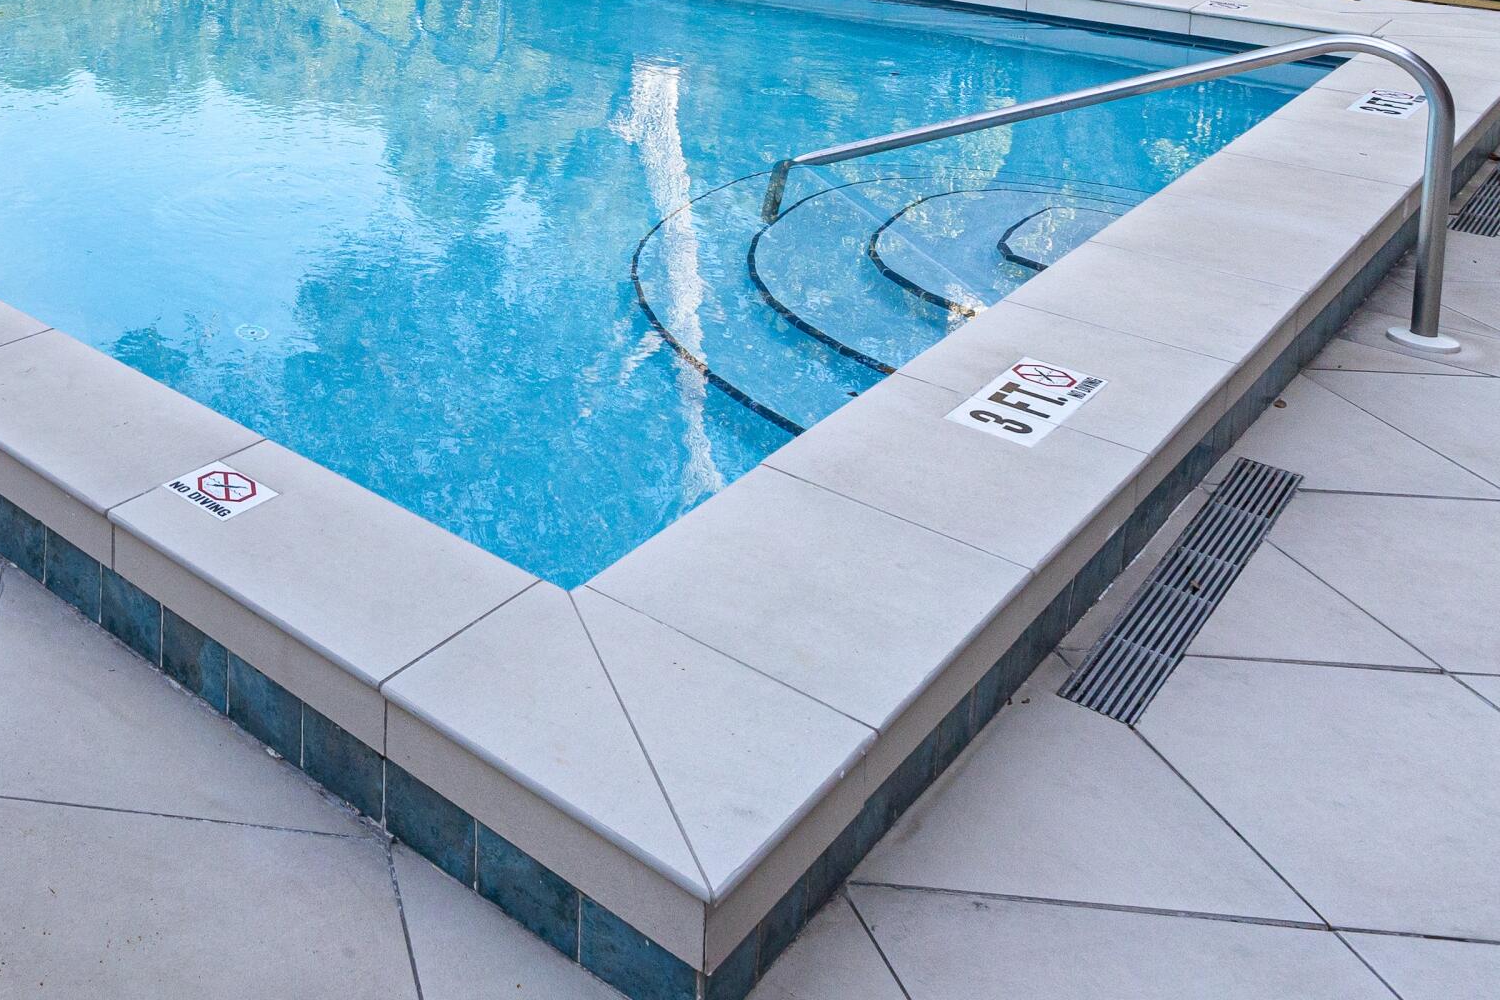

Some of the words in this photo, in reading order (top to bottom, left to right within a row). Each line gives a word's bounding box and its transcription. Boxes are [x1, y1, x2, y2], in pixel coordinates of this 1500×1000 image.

[1359, 106, 1402, 115] 3
[987, 381, 1068, 419] FT.
[969, 410, 1033, 434] 3
[169, 481, 188, 493] NO
[188, 491, 231, 518] DIVING
